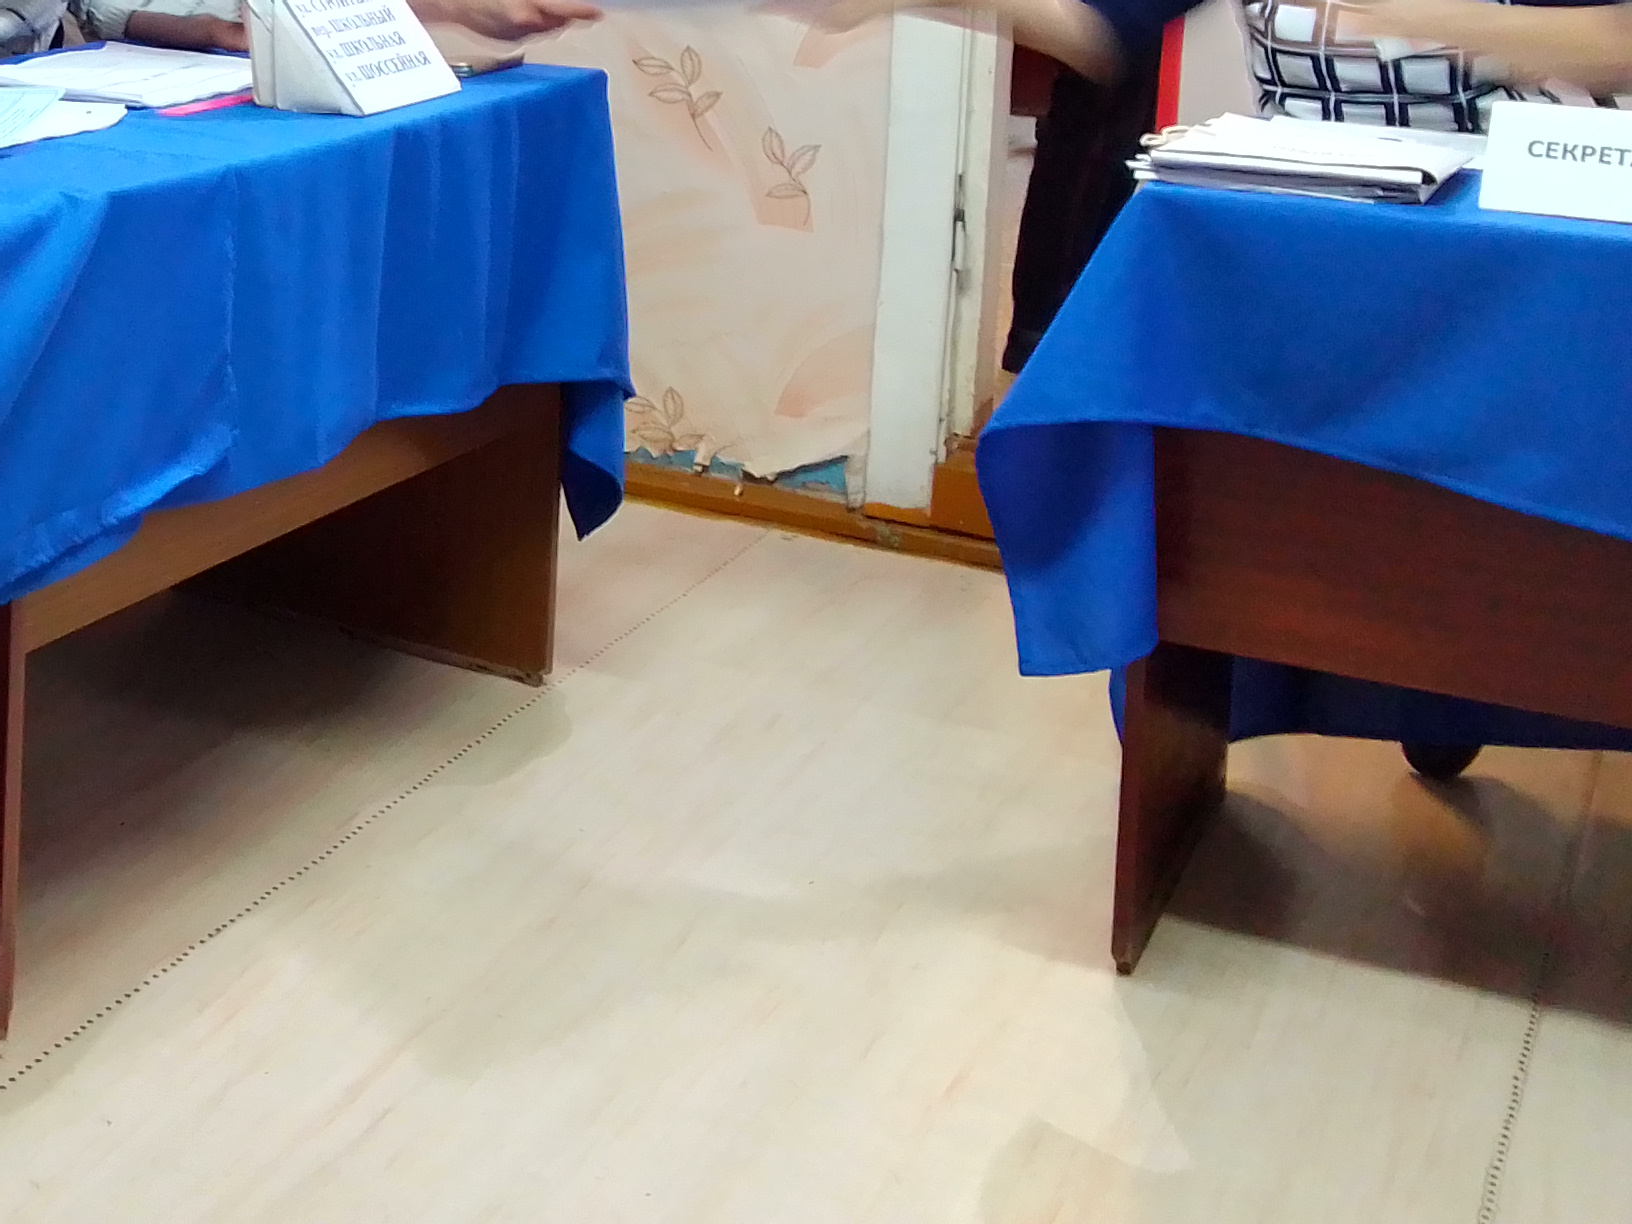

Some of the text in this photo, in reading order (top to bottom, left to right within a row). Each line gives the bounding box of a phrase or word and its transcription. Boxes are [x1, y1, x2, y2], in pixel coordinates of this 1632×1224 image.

[328, 4, 397, 33] ШКОЛЬНЫЙ
[339, 30, 407, 57] ШКОЛЬНАЯ
[357, 50, 432, 80] ШОССЕЙНАЯ
[1527, 139, 1632, 167] СЕКРЕТ
